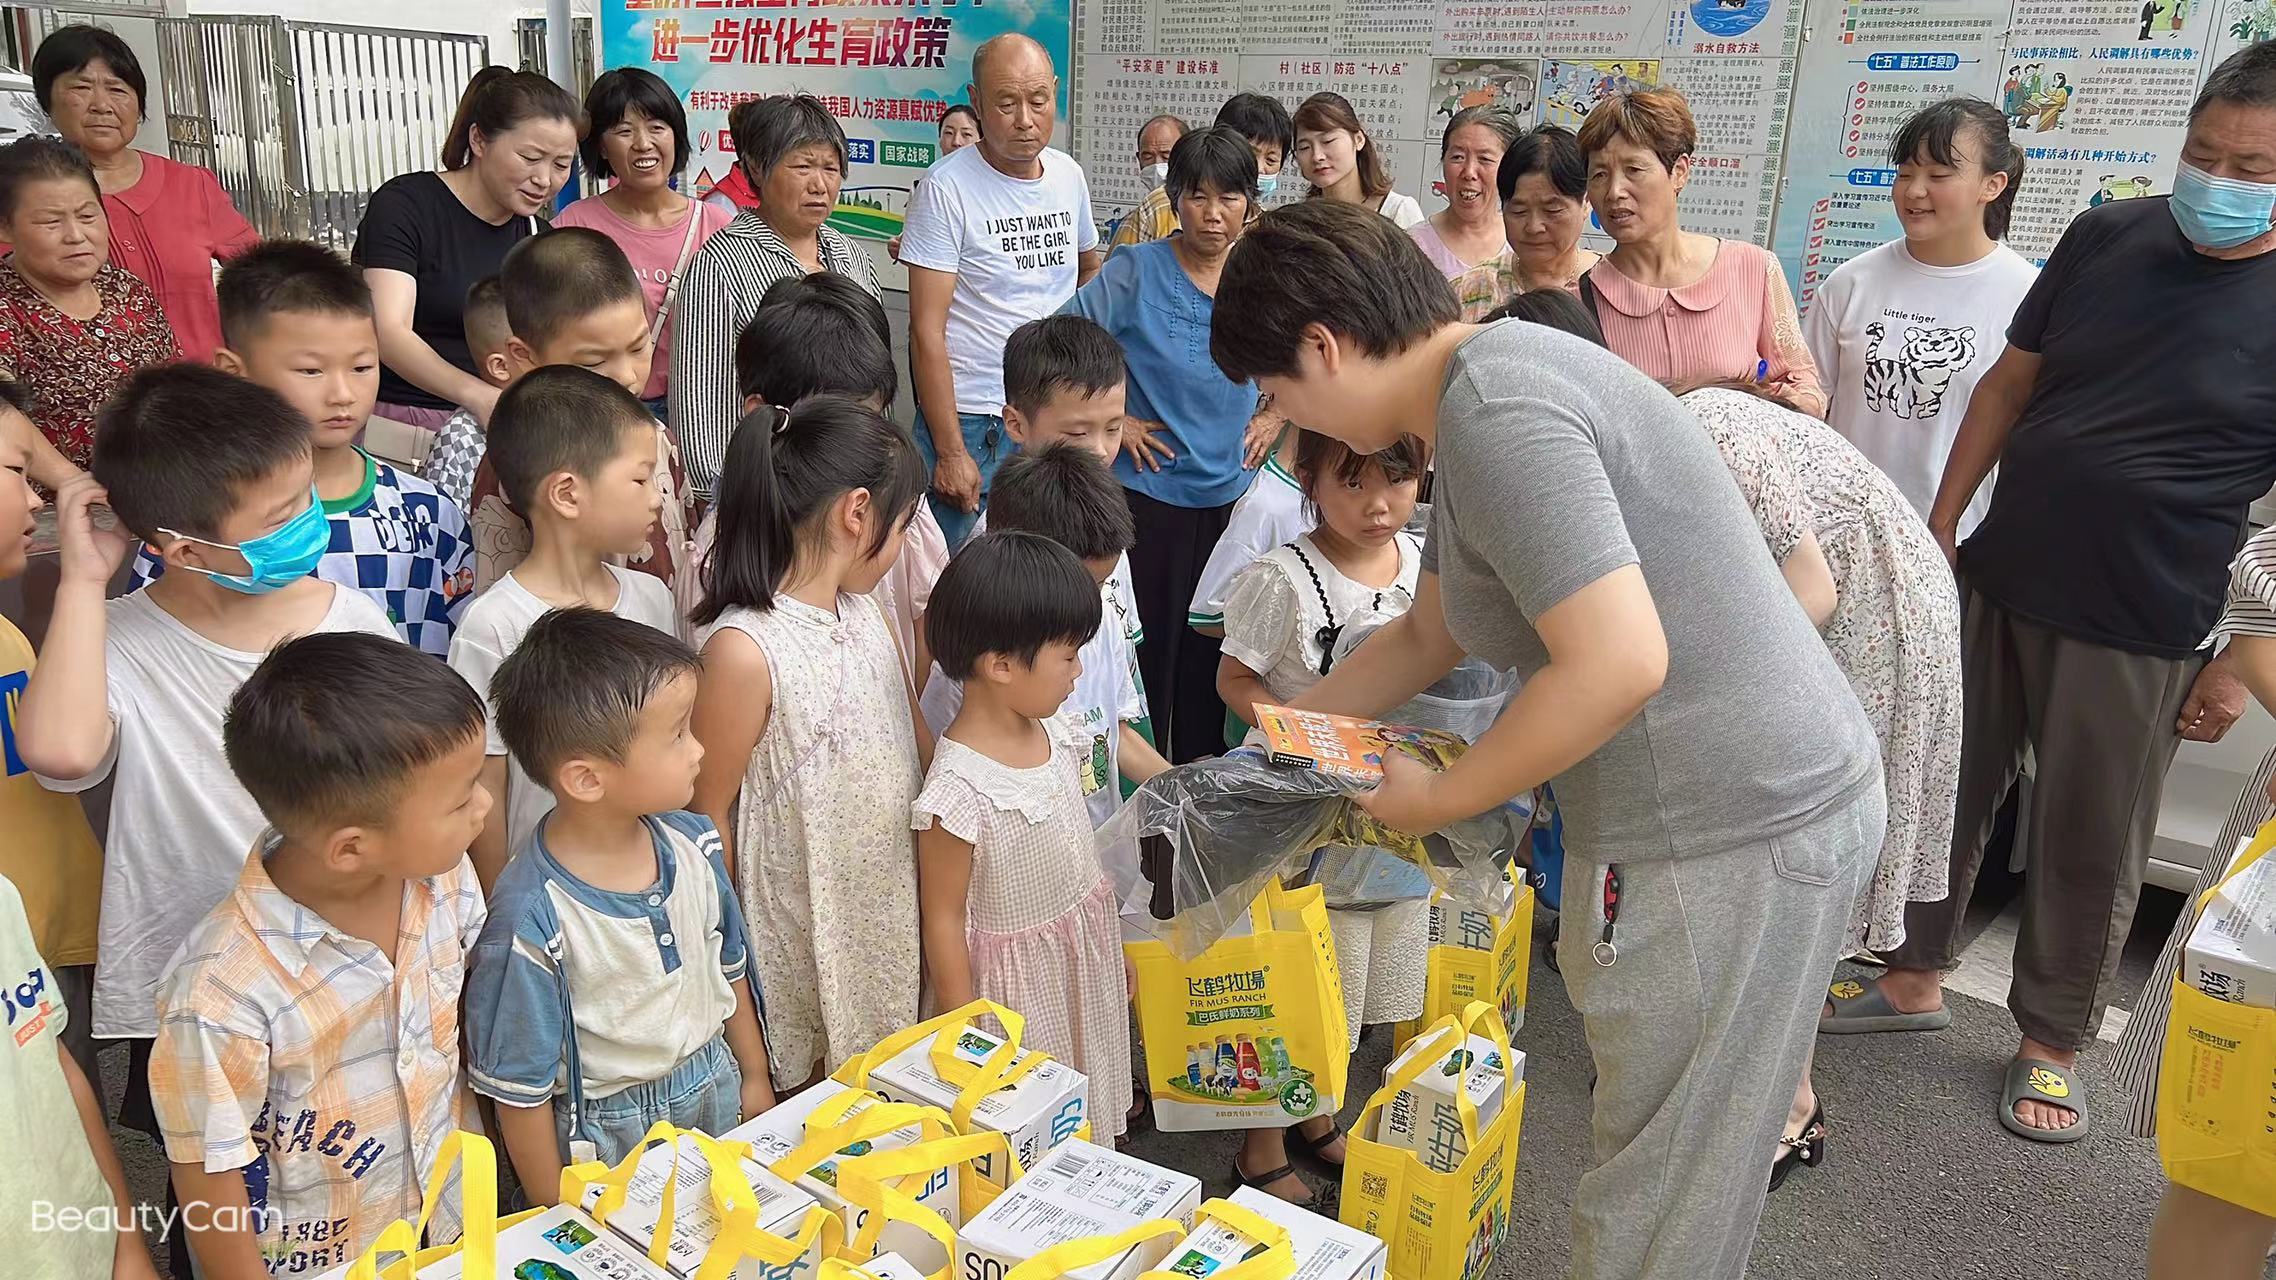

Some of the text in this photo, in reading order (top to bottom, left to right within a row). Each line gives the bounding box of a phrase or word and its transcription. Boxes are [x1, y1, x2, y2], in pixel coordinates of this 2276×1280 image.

[651, 17, 953, 68] 进一步优化生育政策
[1692, 42, 1760, 54] 溺水自救方法
[1871, 55, 1957, 69] “七五”普法工作原则
[2010, 47, 2199, 60] 与民事诉讼相比，人民调解具有哪些优势?
[885, 144, 930, 165] 国家战略
[2025, 147, 2158, 163] 调解活动有几种开始方式?
[986, 211, 1072, 235] I JUST WANT TO
[1001, 231, 1071, 252] BE THE GIRL
[1015, 250, 1066, 270] YOU LIKE
[1883, 308, 1937, 324] Little tiger
[1189, 992, 1267, 1008] FIR MUS RANCH
[2233, 978, 2247, 1004] Ranch
